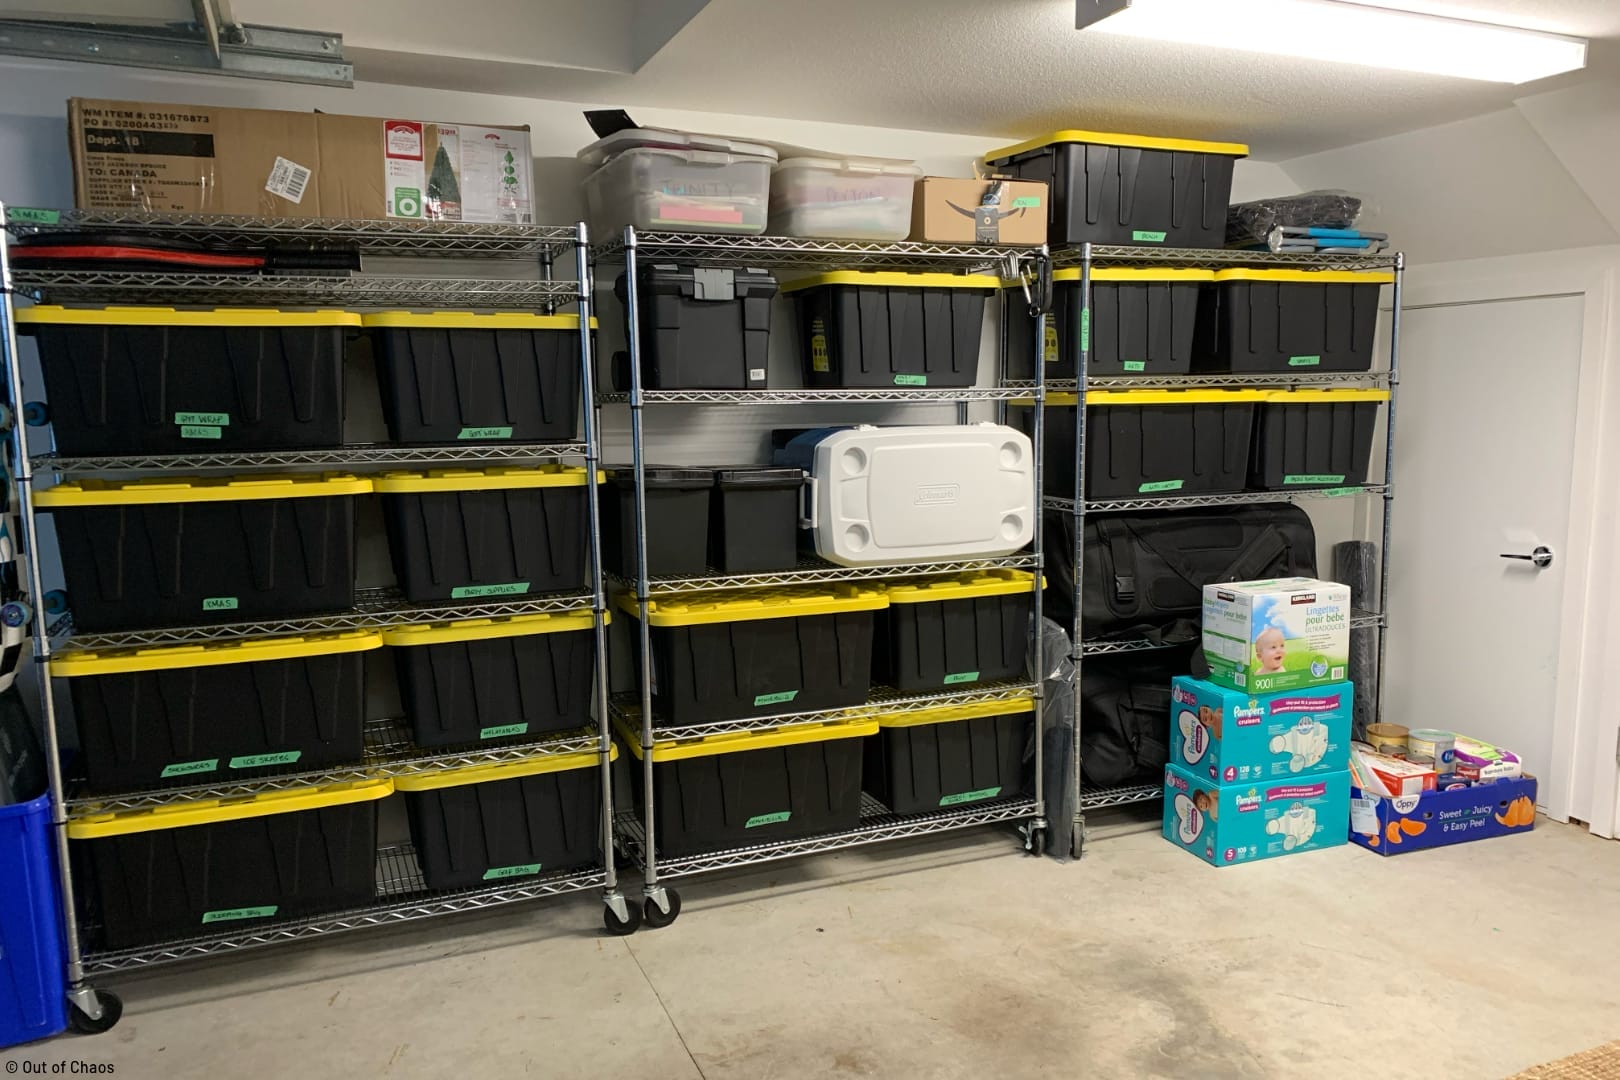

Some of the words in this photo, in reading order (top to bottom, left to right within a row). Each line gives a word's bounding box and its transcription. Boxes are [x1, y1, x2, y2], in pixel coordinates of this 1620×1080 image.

[104, 110, 133, 119] ITEM
[83, 118, 98, 126] PO
[87, 134, 120, 146] Dept.
[88, 168, 106, 176] TO:
[110, 169, 157, 178] CANADA
[206, 599, 232, 608] XMAS
[1306, 605, 1340, 616] Lingettes
[1305, 615, 1324, 626] pour
[1255, 678, 1271, 690] 900
[1233, 705, 1265, 718] Pampers
[1227, 767, 1234, 777] 4
[1439, 809, 1462, 820] Sweet
[1472, 805, 1493, 815] Juicy
[1443, 823, 1449, 832] &
[1450, 822, 1469, 832] Easy
[1469, 817, 1486, 829] Peel
[1227, 849, 1233, 858] 5
